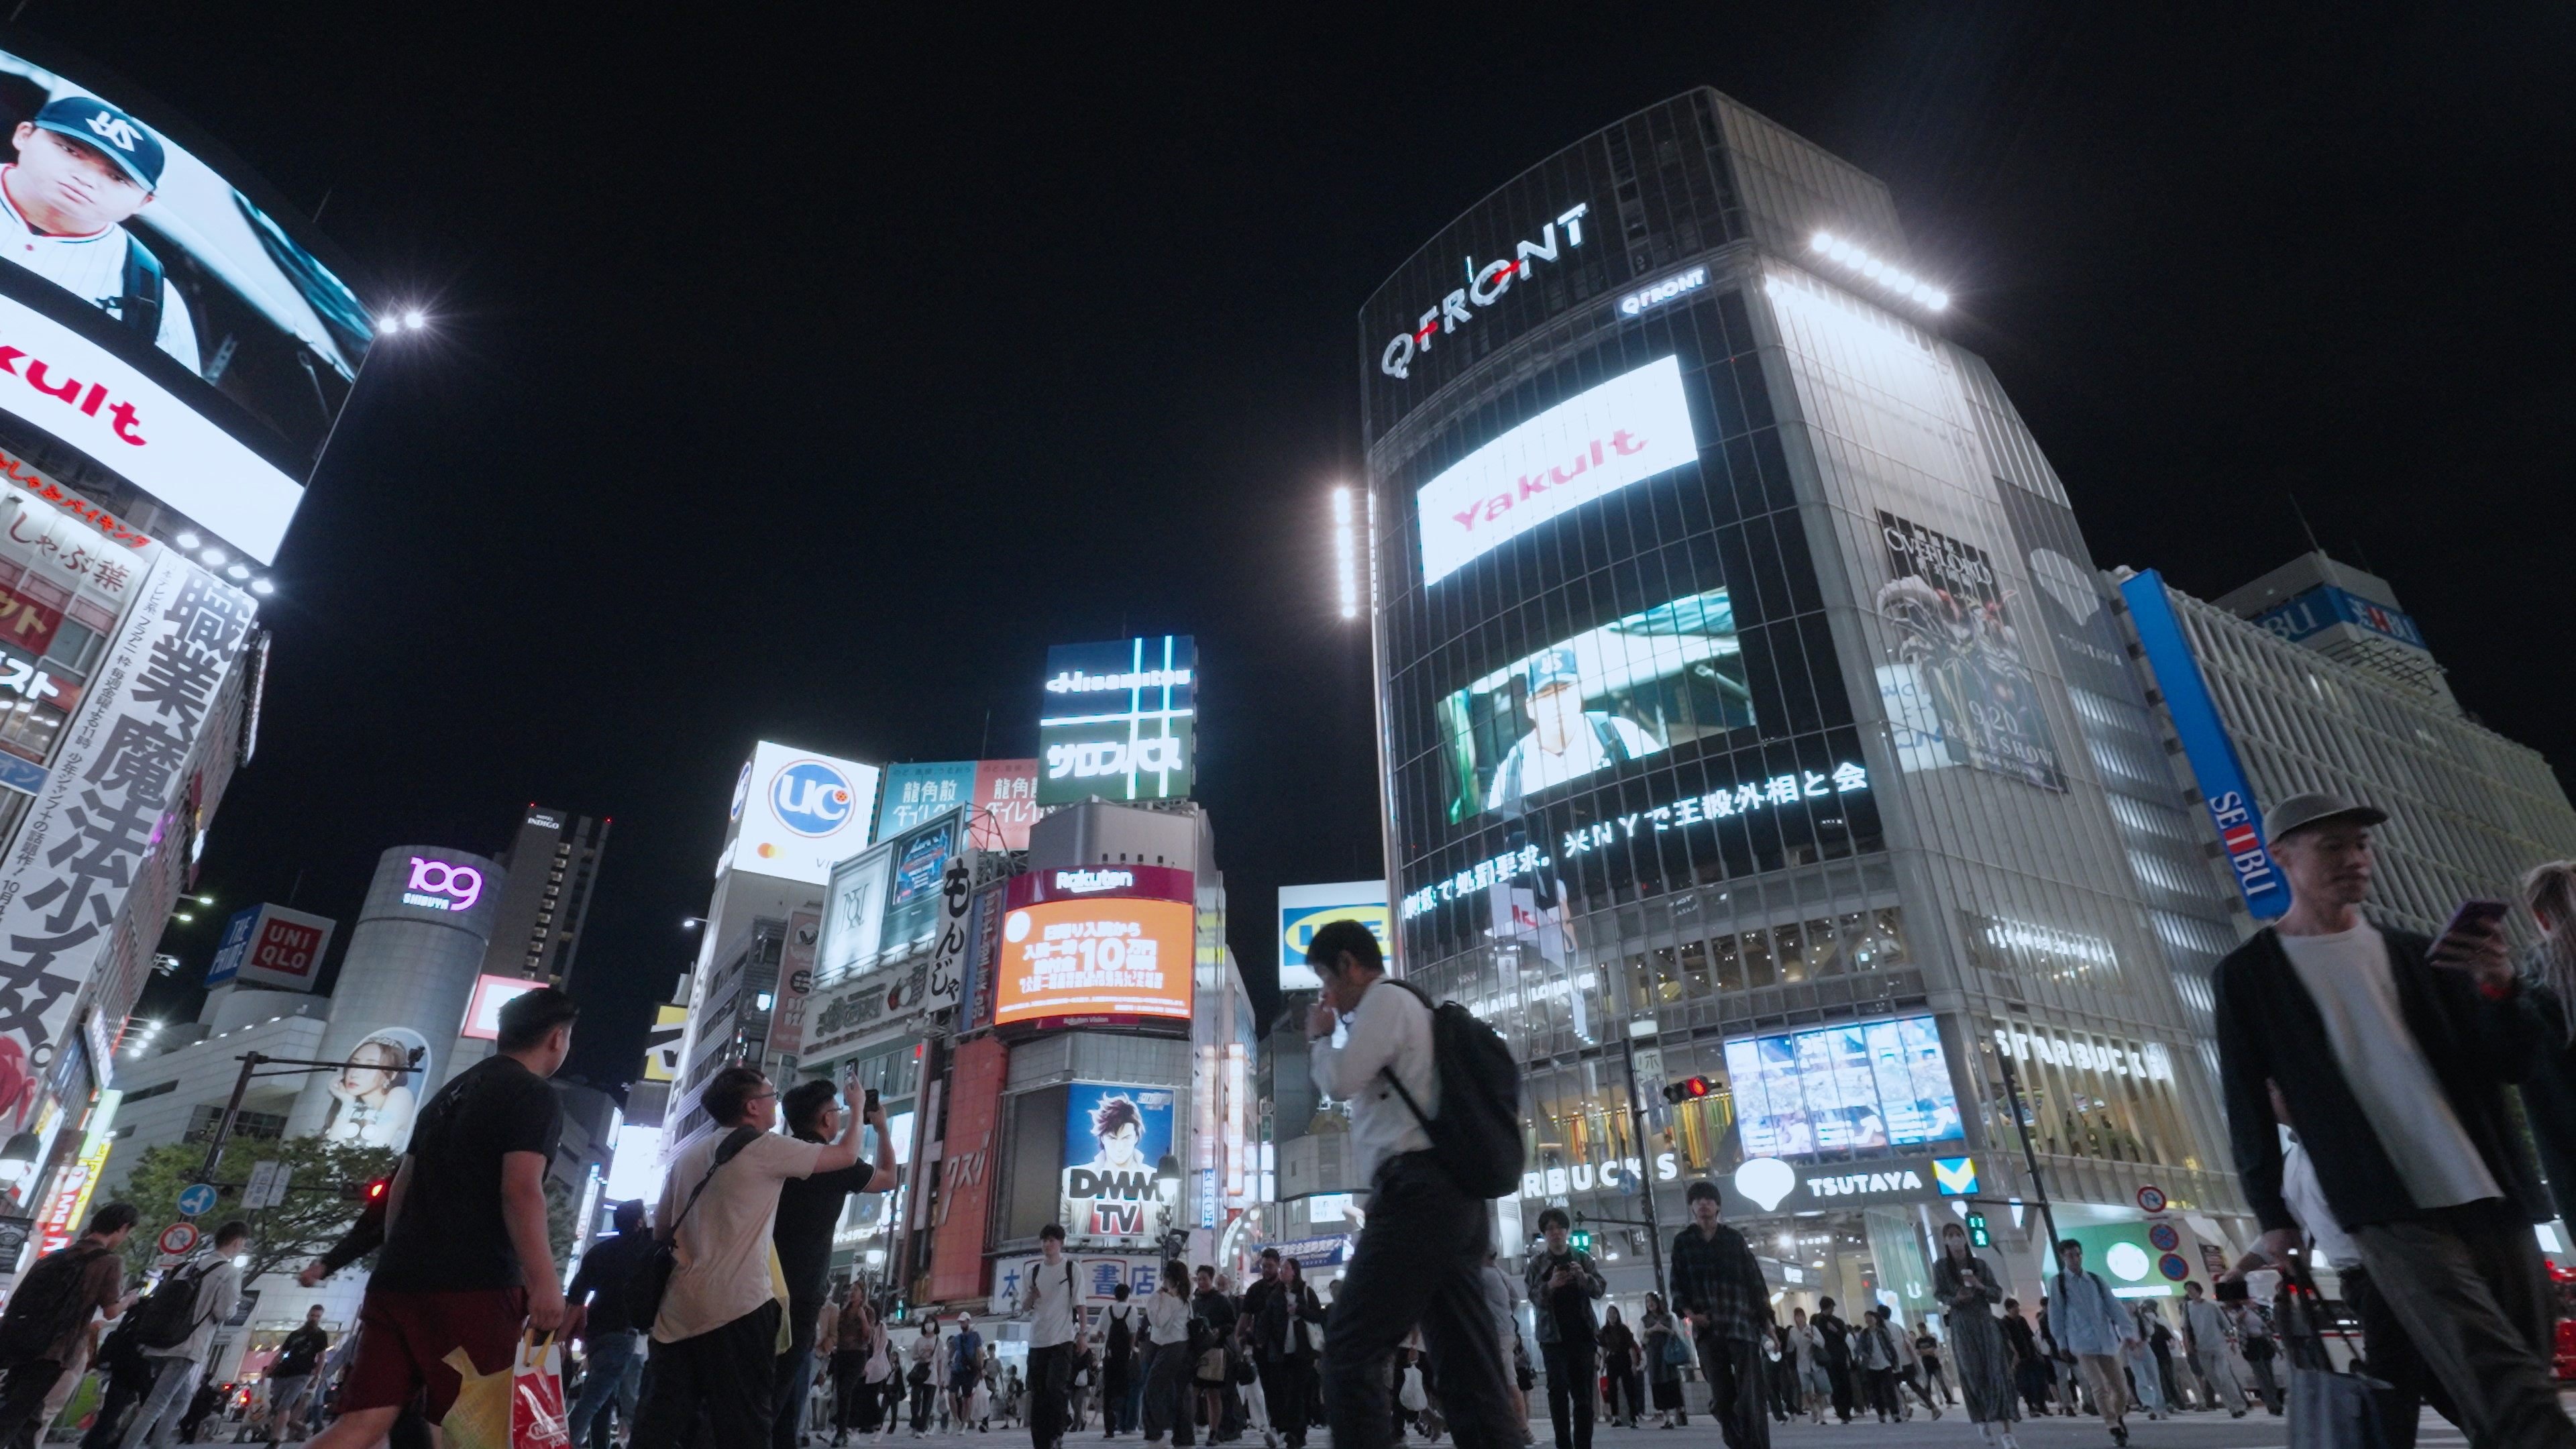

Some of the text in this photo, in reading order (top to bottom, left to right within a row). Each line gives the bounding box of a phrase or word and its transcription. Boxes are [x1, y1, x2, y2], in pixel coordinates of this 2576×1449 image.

[1382, 203, 1589, 378] QFRONT
[1621, 269, 1707, 315] QFRONT
[1452, 428, 1649, 532] Yakult
[9, 511, 131, 593] しゃぶ葉
[1046, 669, 1191, 693] Hisamitsu
[1047, 737, 1183, 778] サロンパス
[903, 779, 958, 804] 龍角散
[527, 817, 560, 830] INDIGO
[2210, 790, 2277, 897] SEIBU
[408, 857, 483, 911] 109
[1056, 869, 1134, 893] Rakuten
[402, 893, 450, 910] SHIBUYA
[269, 925, 310, 950] UNI
[932, 857, 970, 1002] もんじゃ
[261, 946, 307, 969] QLO
[1069, 1169, 1164, 1201] DMM
[1808, 1170, 1922, 1197] TSUTAYA
[1096, 1205, 1139, 1233] TV
